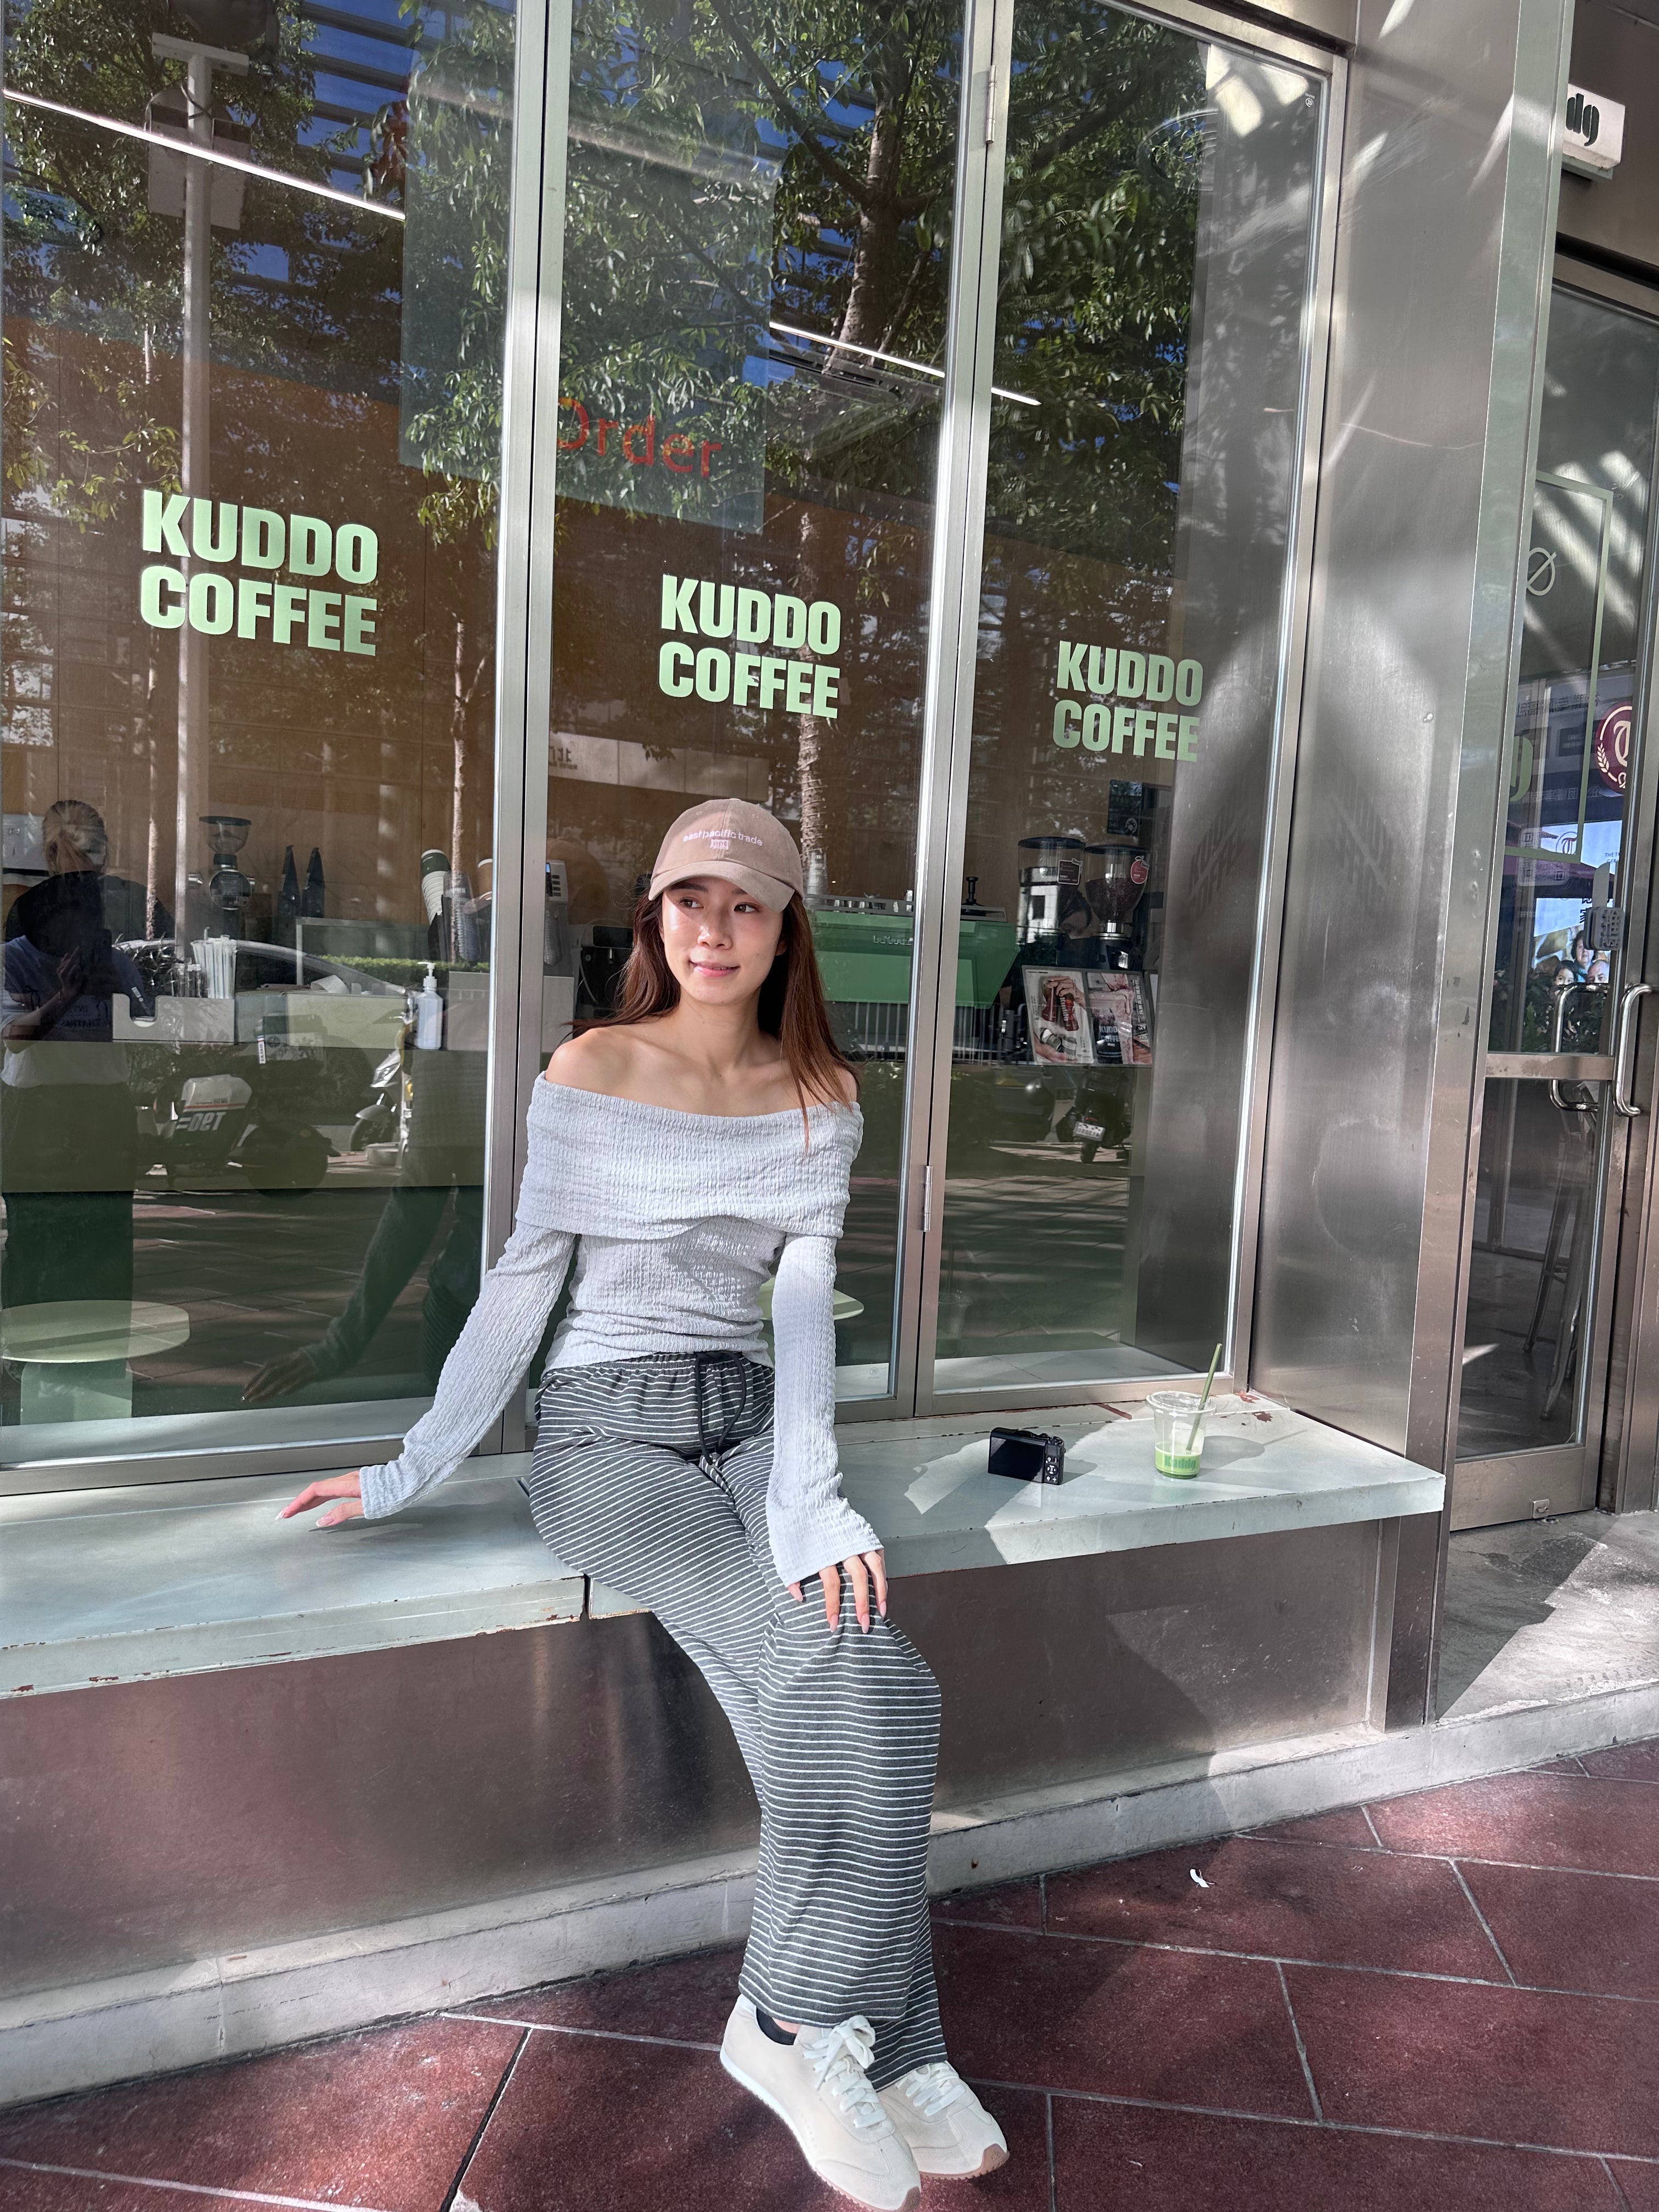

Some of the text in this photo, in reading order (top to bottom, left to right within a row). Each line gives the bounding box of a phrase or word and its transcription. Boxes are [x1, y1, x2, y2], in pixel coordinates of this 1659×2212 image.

[143, 489, 378, 584] KUDDO
[141, 566, 377, 656] COFFEE
[661, 574, 841, 654] KUDDO
[659, 642, 840, 719] COFFEE
[1057, 640, 1204, 706] KUDDO
[1053, 699, 1200, 762] COFFEE
[682, 829, 763, 847] east pacific trade
